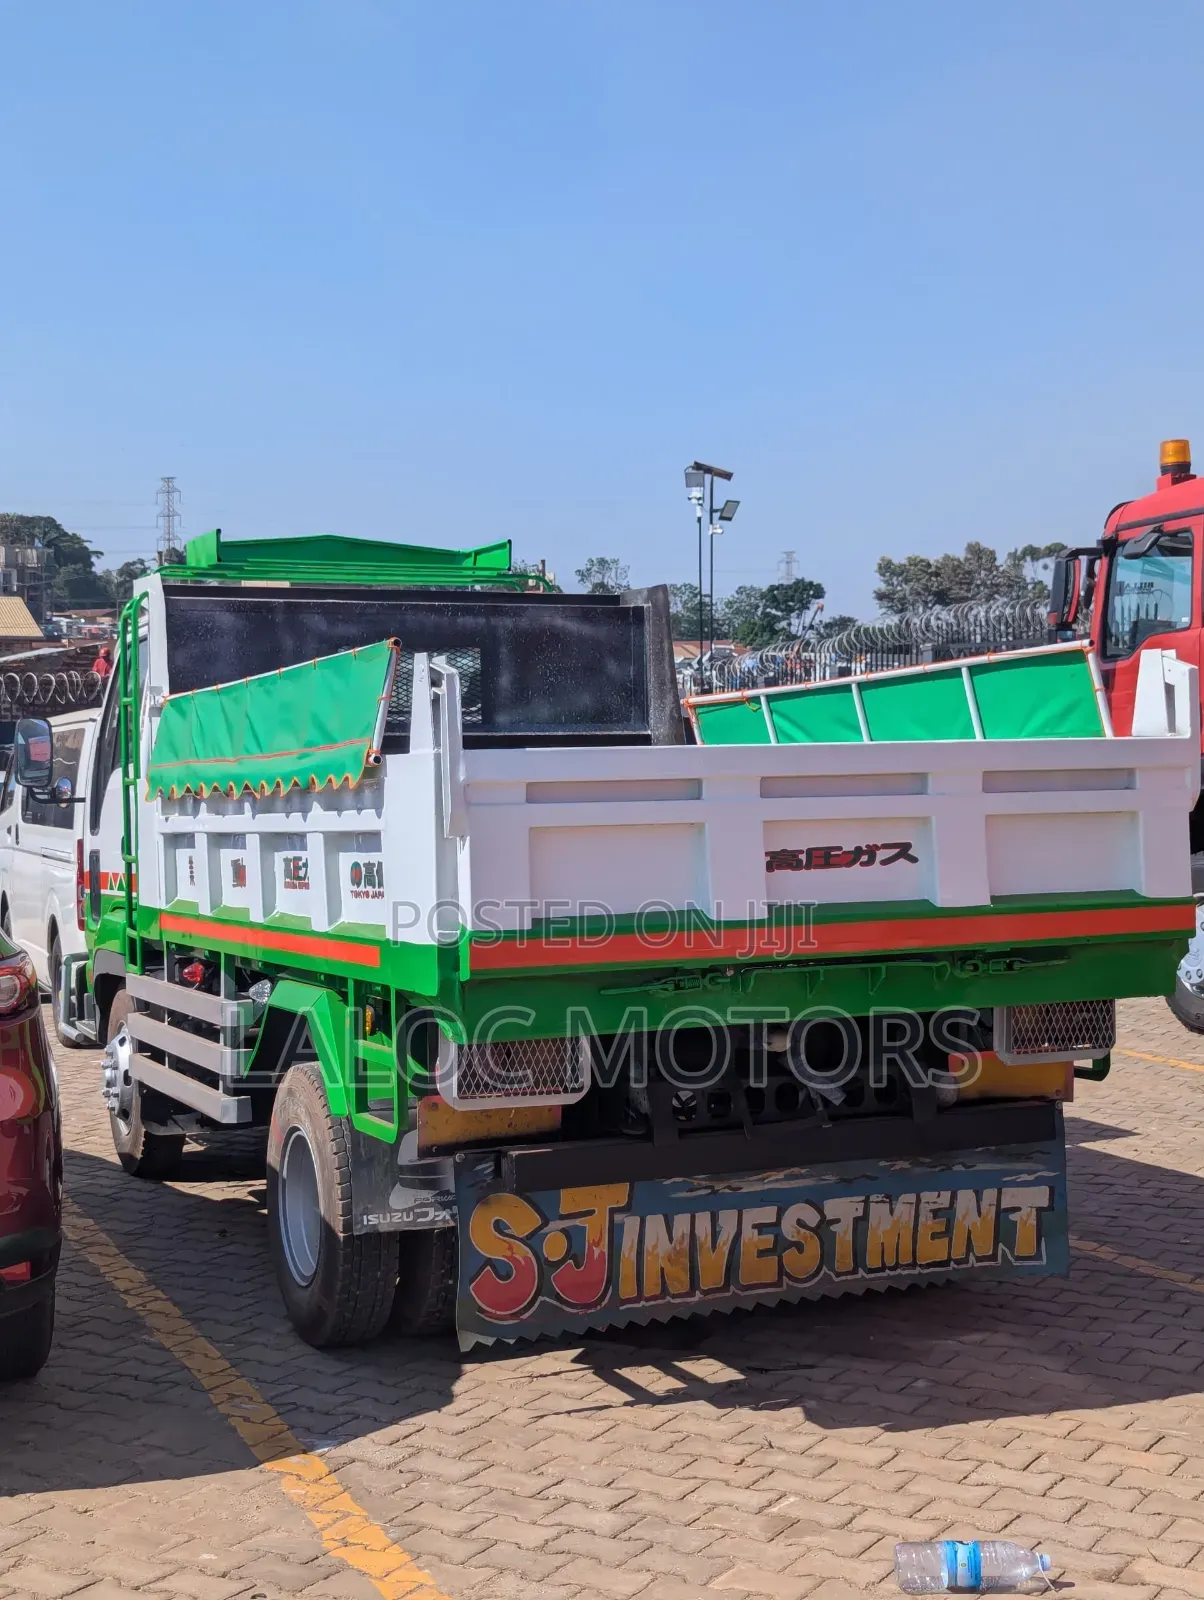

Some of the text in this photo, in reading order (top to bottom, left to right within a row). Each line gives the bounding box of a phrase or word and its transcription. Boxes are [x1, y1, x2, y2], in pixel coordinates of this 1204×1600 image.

[764, 842, 920, 872] 高圧ガス
[350, 890, 370, 899] TOKYO
[363, 1213, 414, 1226] ISUZU
[617, 1186, 1053, 1304] INVESTMENT
